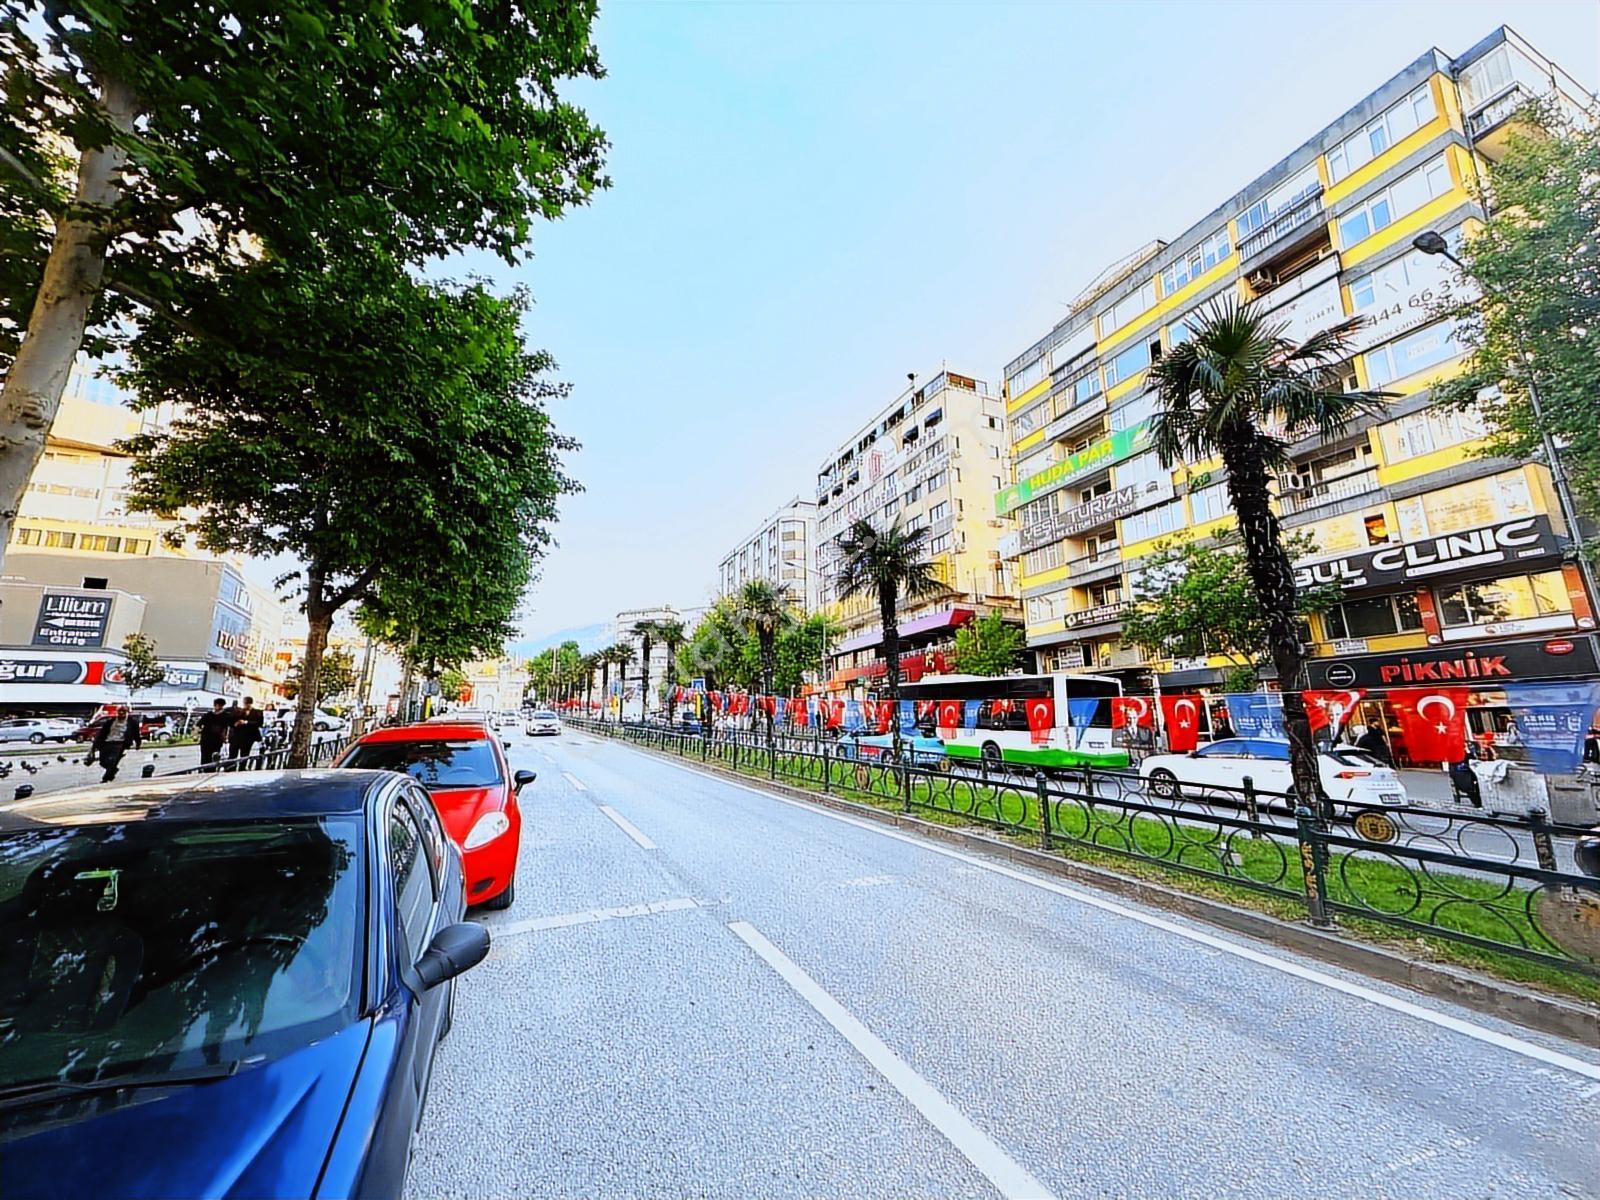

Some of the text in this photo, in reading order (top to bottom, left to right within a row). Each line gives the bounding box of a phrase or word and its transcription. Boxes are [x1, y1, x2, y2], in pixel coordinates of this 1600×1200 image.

[1408, 291, 1433, 308] 66
[1077, 440, 1113, 469] PAR
[1069, 485, 1134, 521] TURİZM
[1371, 518, 1541, 571] CLINIC
[46, 596, 105, 614] Lilium
[39, 628, 99, 637] Entrance
[1380, 650, 1512, 683] PİKNİK
